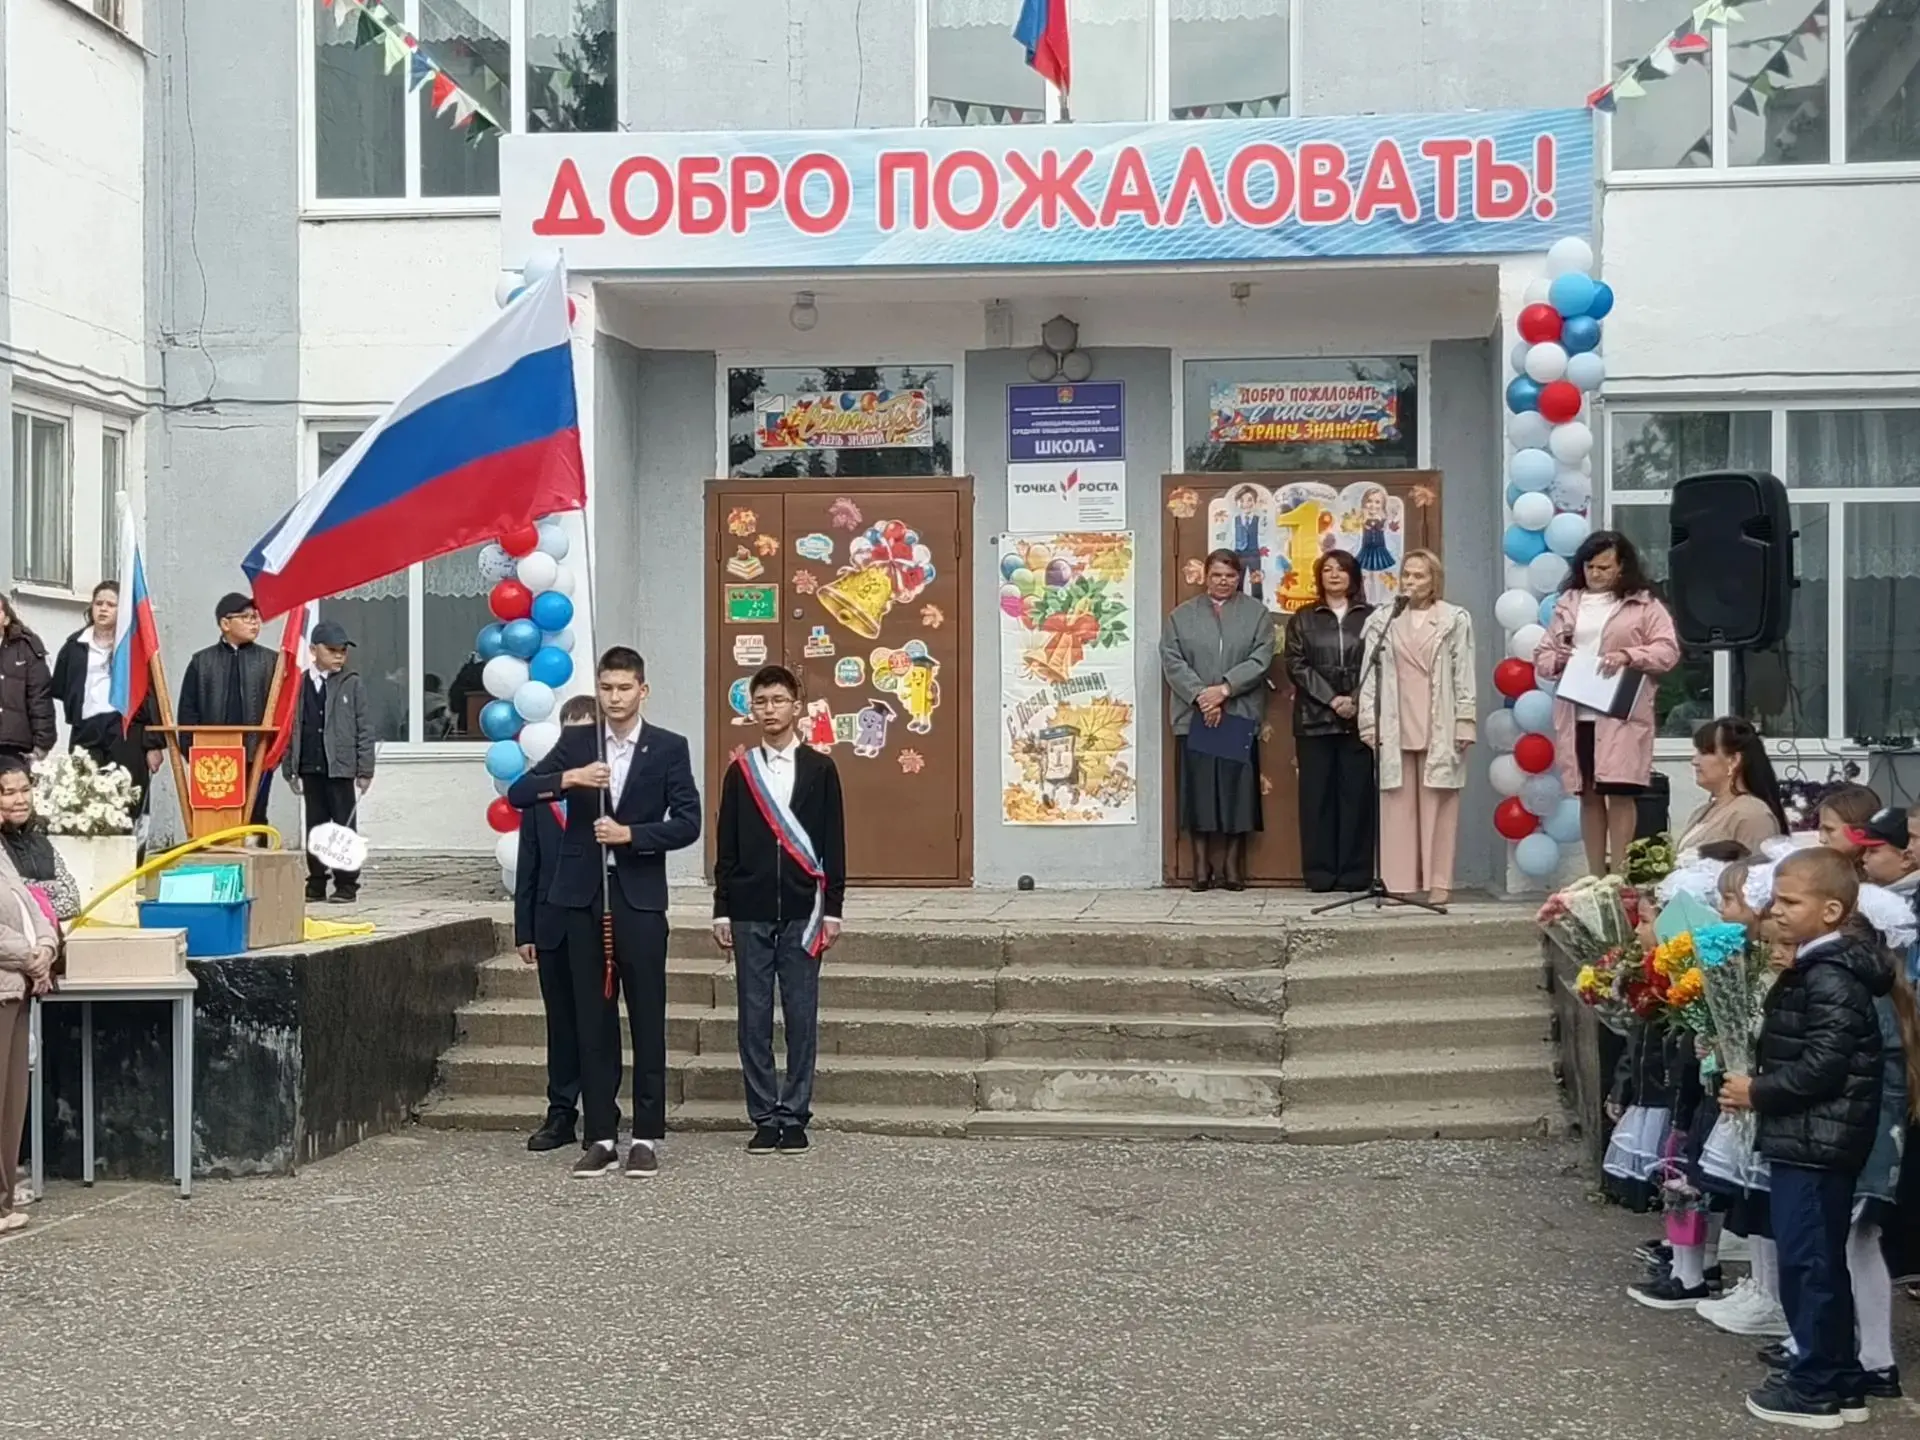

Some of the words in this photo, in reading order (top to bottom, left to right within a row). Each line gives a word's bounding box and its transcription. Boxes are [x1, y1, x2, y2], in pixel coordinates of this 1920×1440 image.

[534, 155, 848, 235] ДОБРО
[881, 139, 1552, 229] ПОЖАЛОВАТЬ!
[1240, 387, 1285, 404] ДОБРО
[1290, 386, 1379, 402] ПОЖАЛОВАТЬ
[1238, 423, 1299, 440] СТРАНУ
[1304, 420, 1376, 439] ЗНАНИЙ!
[1014, 483, 1057, 495] ТОЧКА
[1078, 481, 1120, 493] РОСТА
